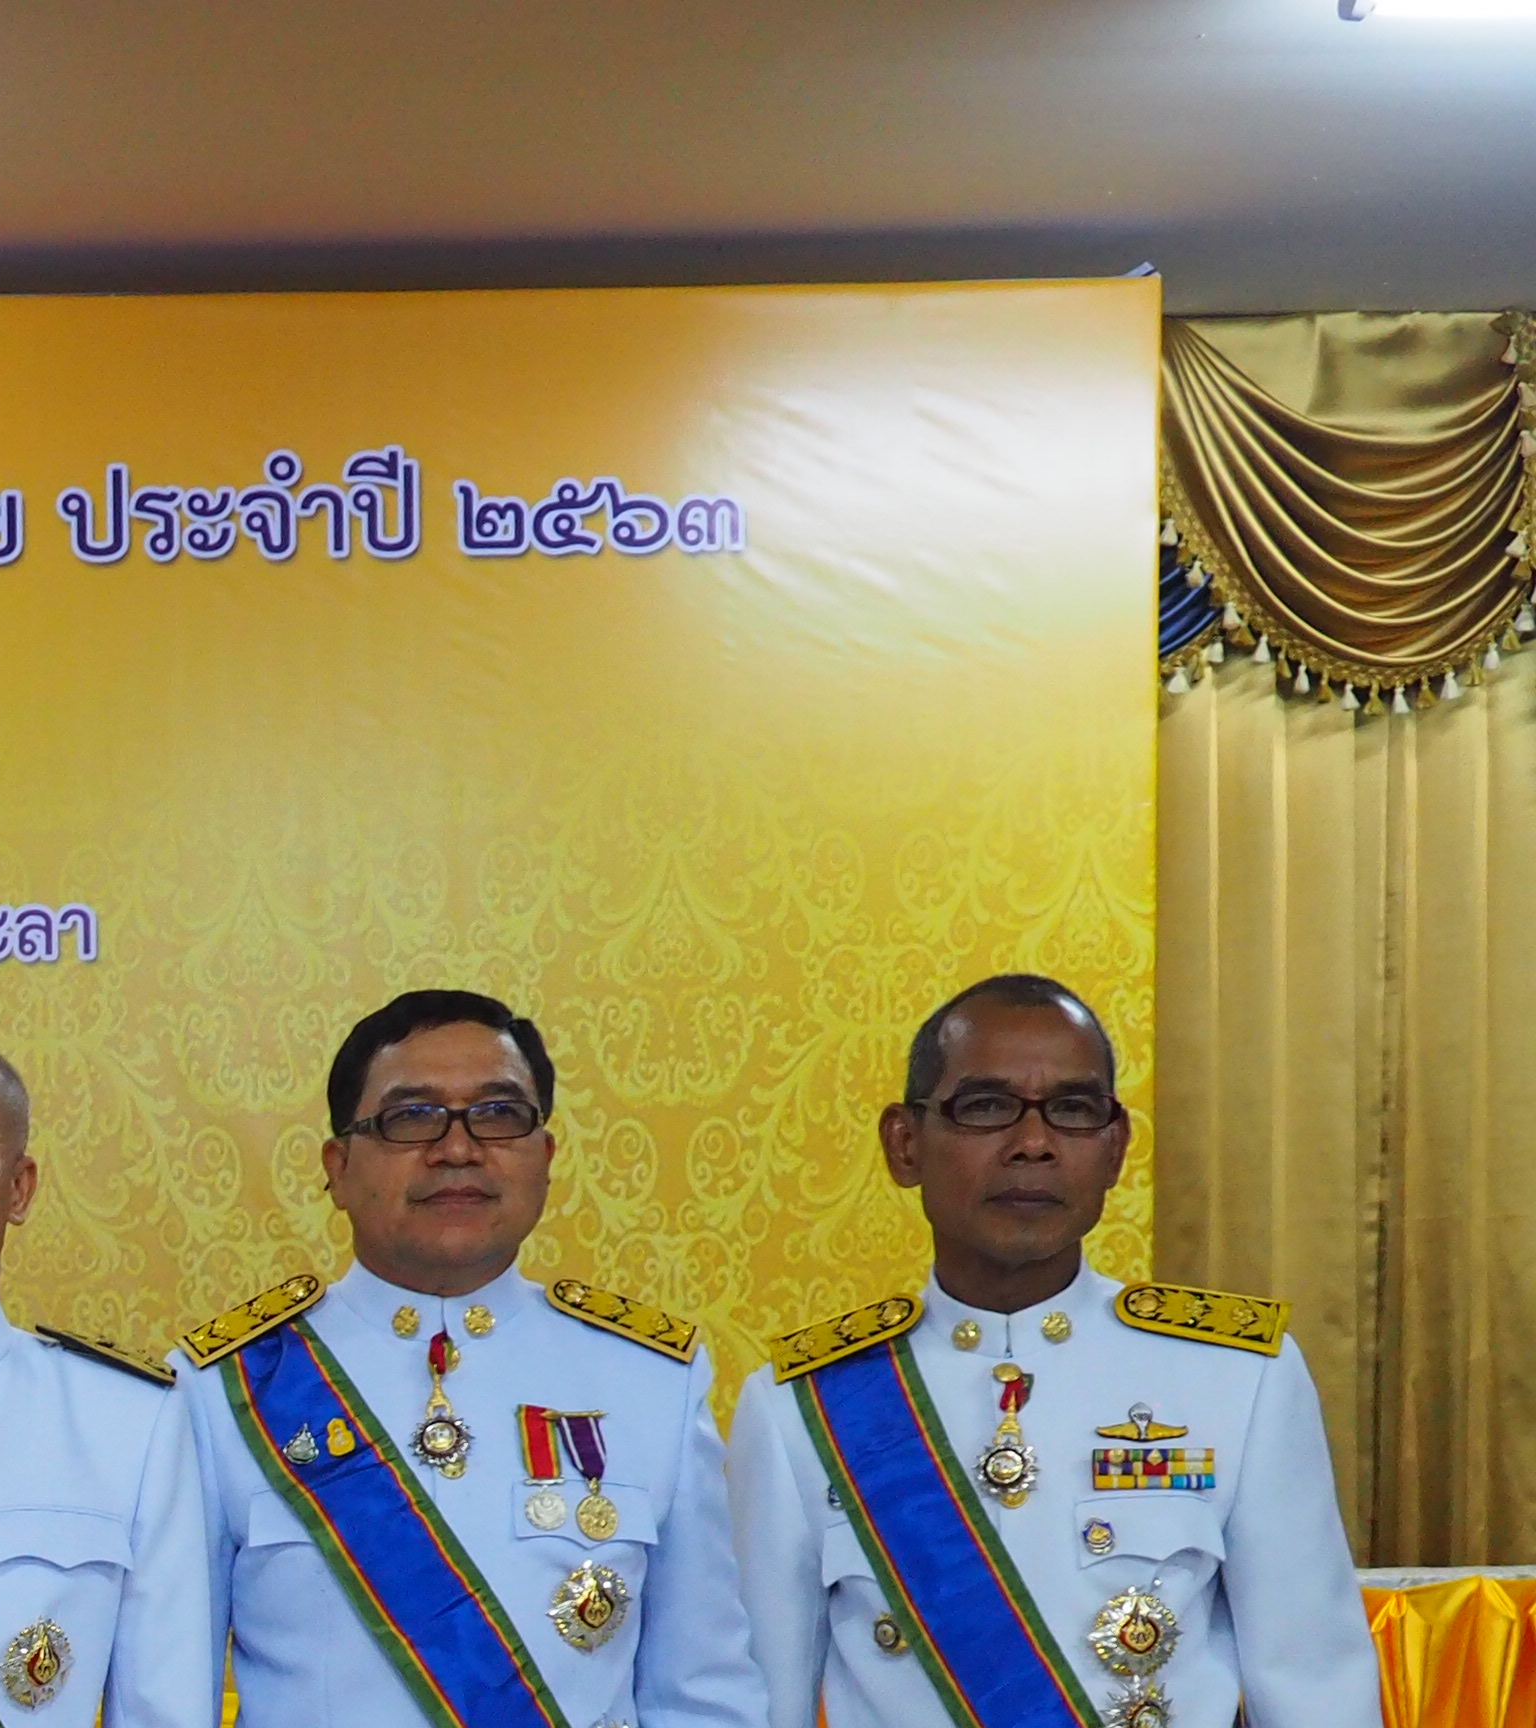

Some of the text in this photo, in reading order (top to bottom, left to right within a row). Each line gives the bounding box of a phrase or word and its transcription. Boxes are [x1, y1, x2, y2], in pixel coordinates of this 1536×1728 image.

[60, 446, 418, 560] ประจำปี
[456, 477, 744, 554] ๒๕๖๓
